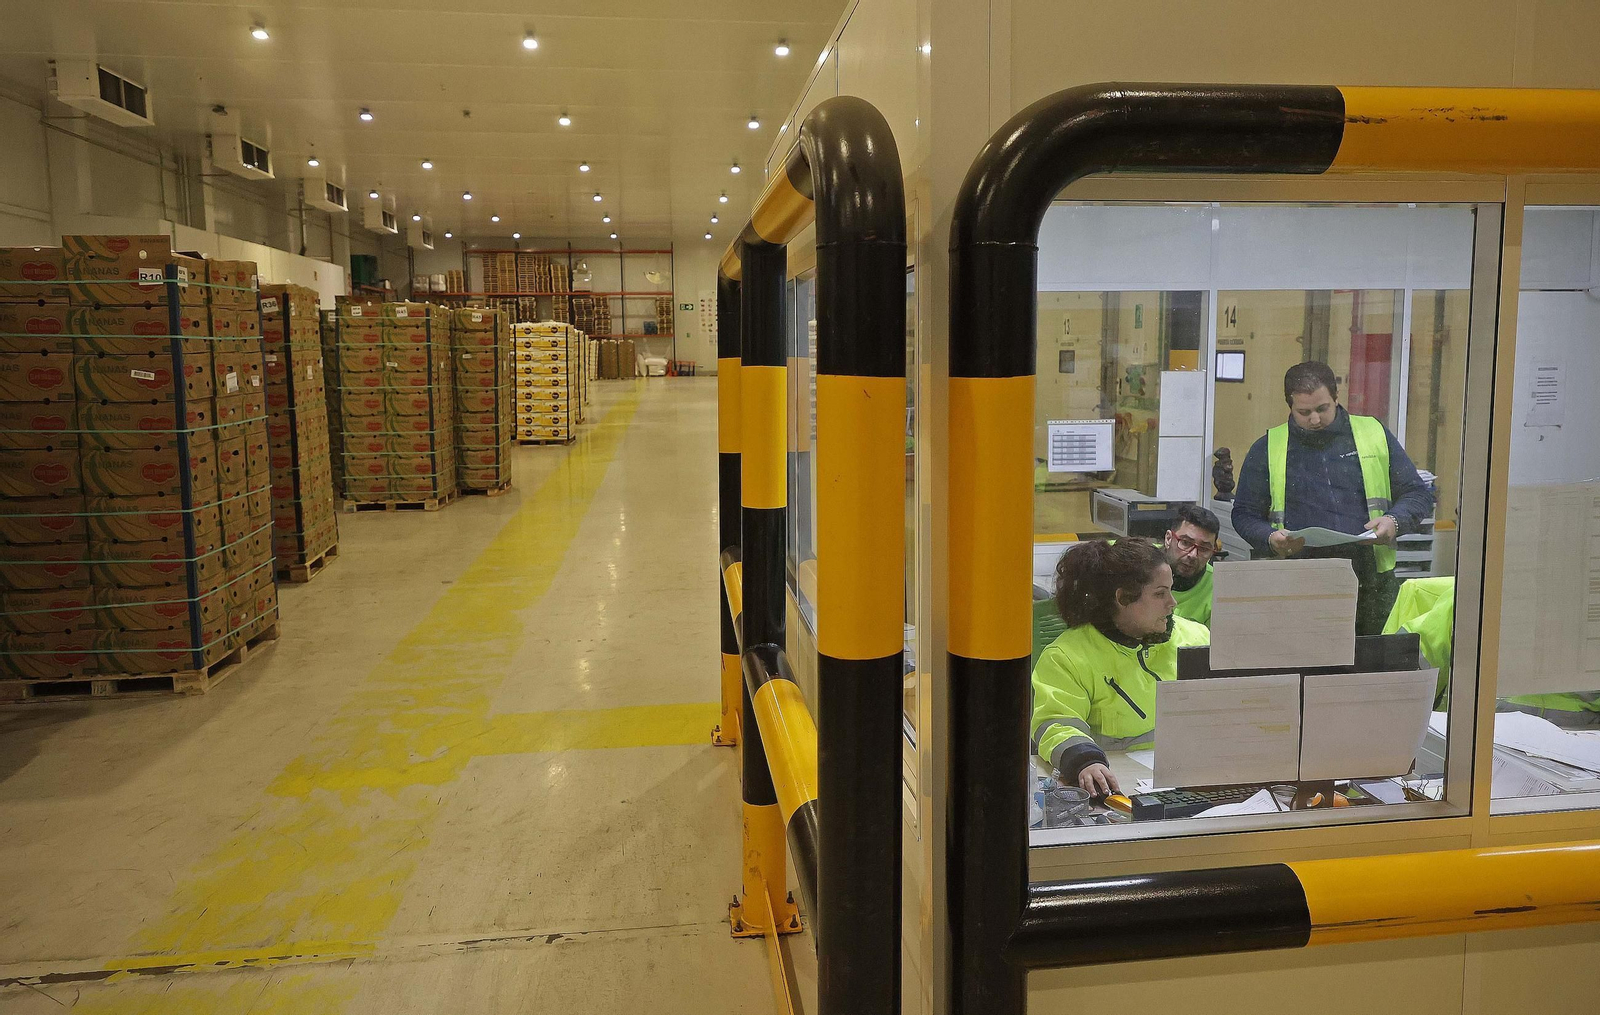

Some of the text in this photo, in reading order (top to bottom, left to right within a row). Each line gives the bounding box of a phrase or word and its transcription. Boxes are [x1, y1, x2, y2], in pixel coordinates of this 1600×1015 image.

[140, 273, 162, 281] R10
[262, 300, 277, 309] R36
[1224, 305, 1237, 328] 14
[1063, 318, 1071, 335] 13
